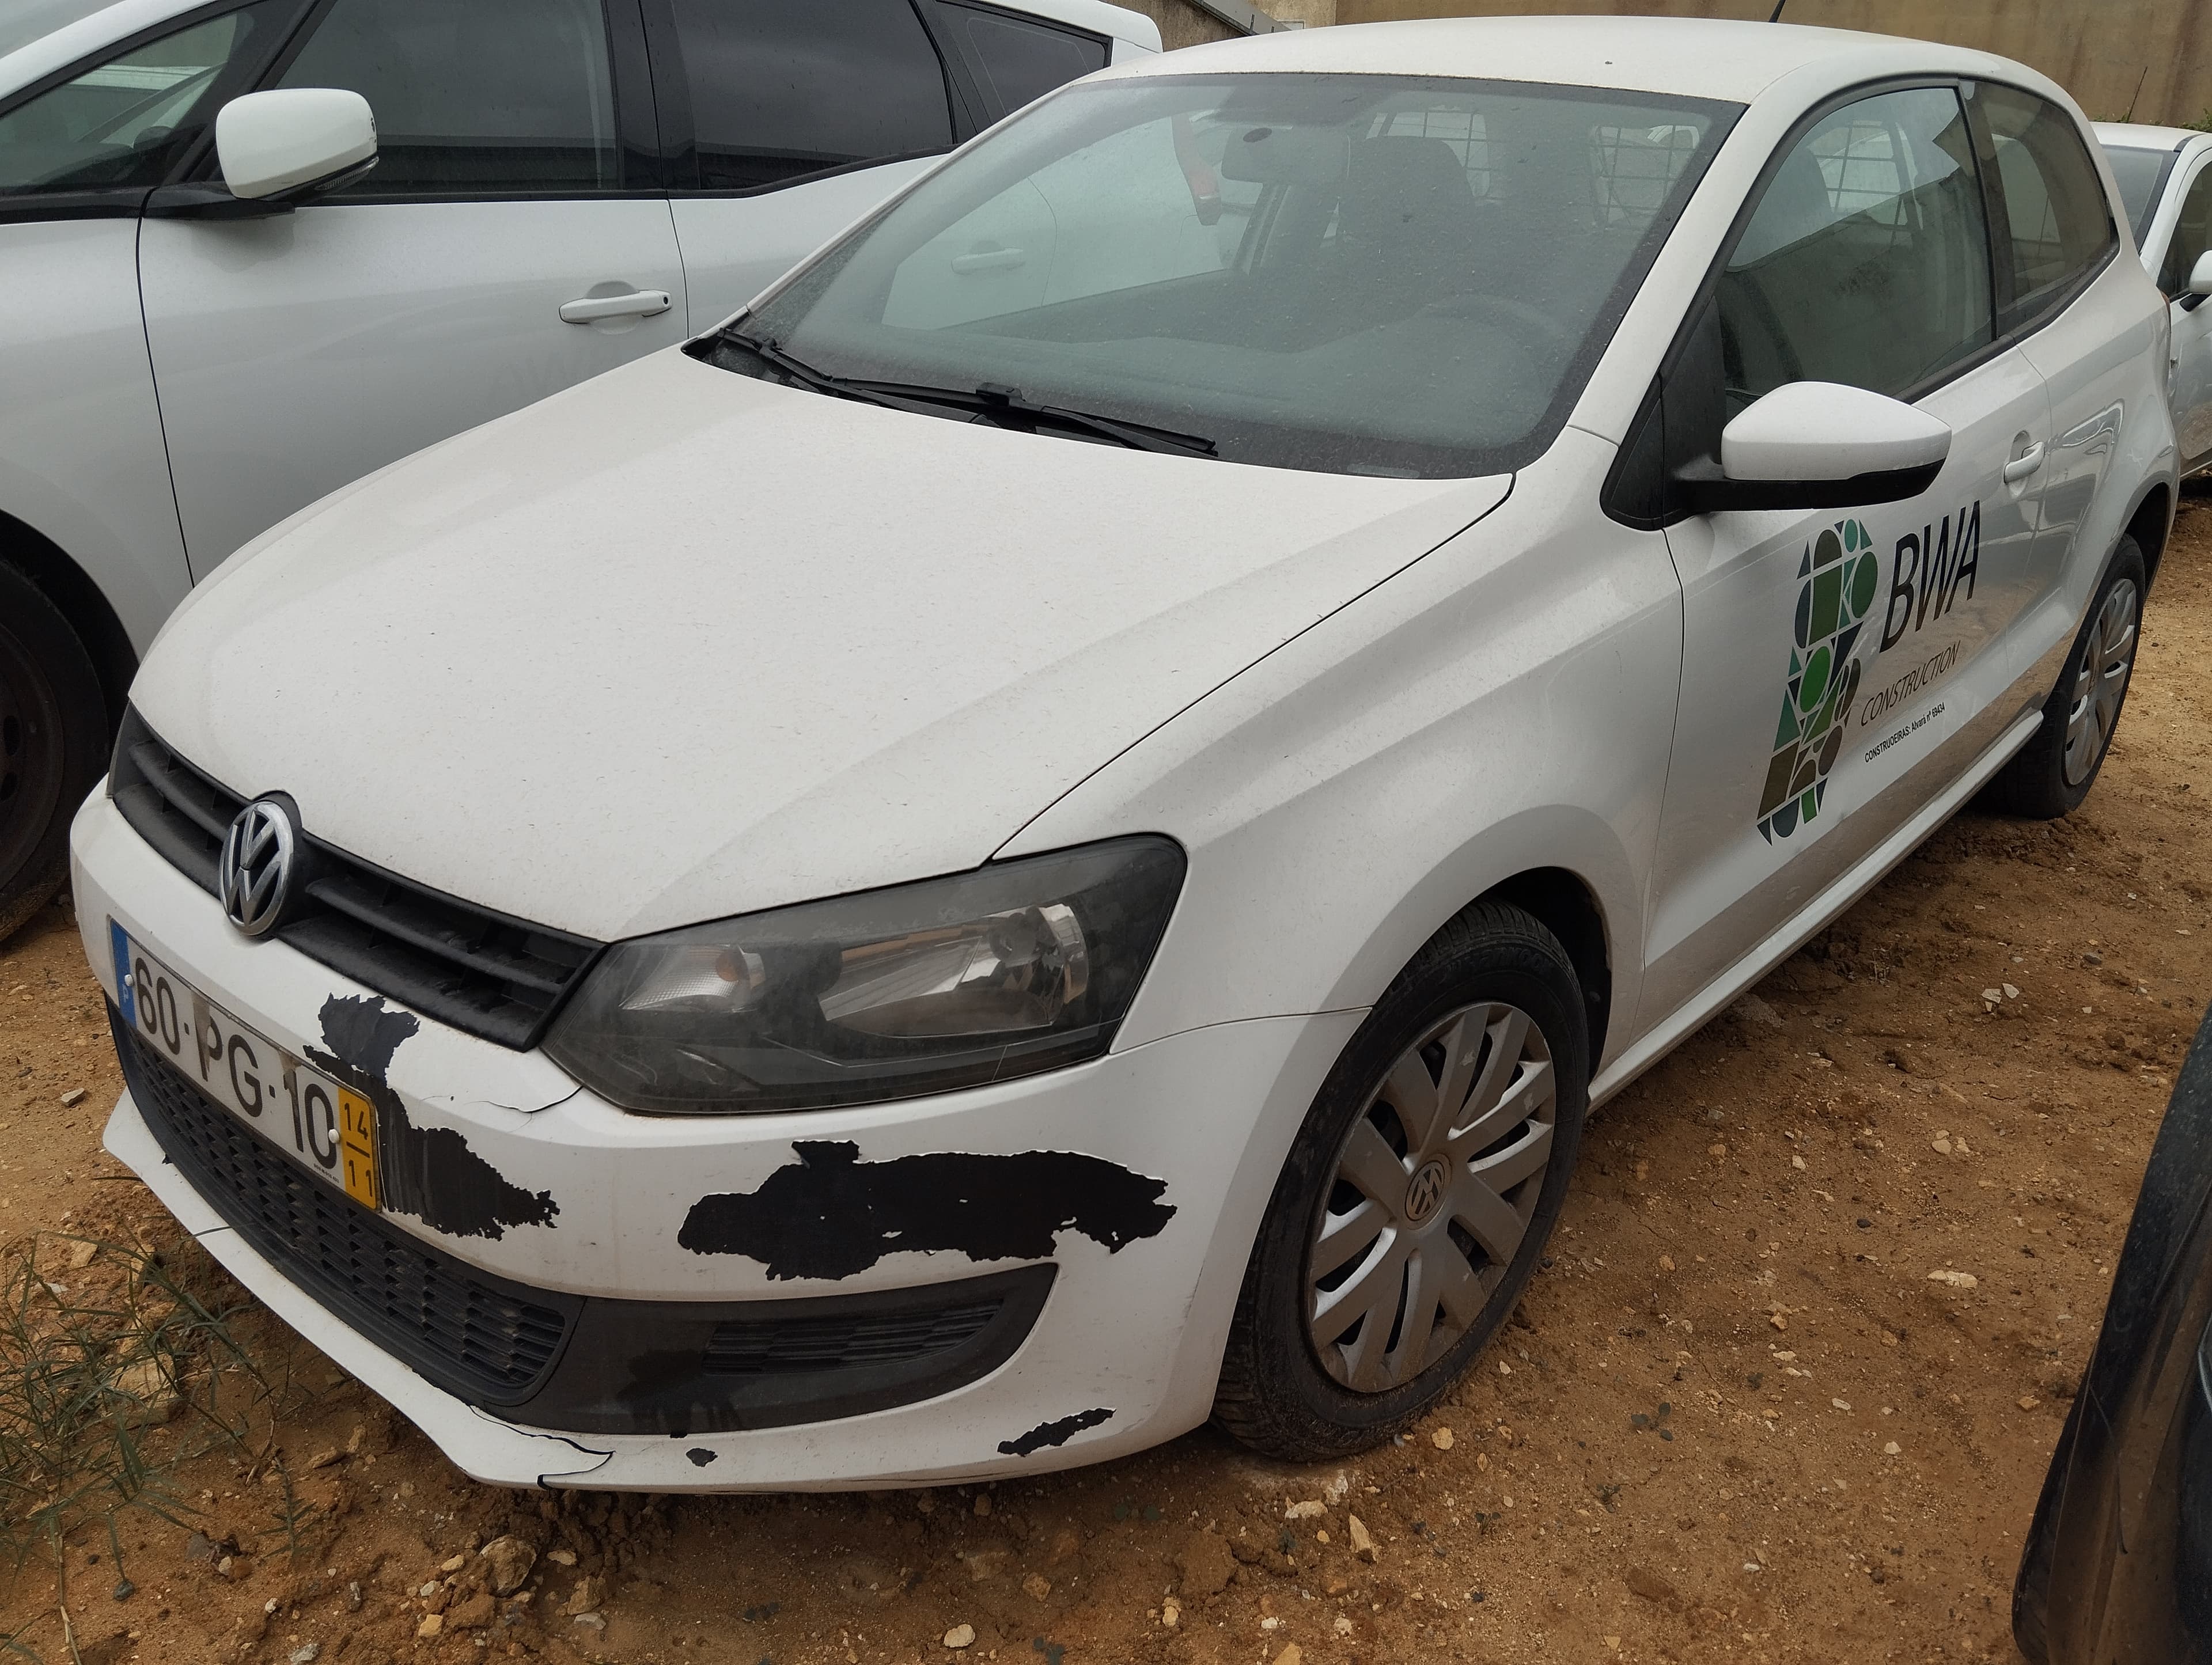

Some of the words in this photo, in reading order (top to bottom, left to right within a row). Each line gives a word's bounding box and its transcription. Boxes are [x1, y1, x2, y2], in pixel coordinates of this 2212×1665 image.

[1879, 500, 1980, 653] BWA
[1861, 640, 1960, 726] CONSTRUCTION
[1911, 714, 1926, 733] Alvará
[1932, 702, 1945, 718] 69434
[344, 1102, 369, 1140] 14
[349, 1159, 373, 1197] 11
